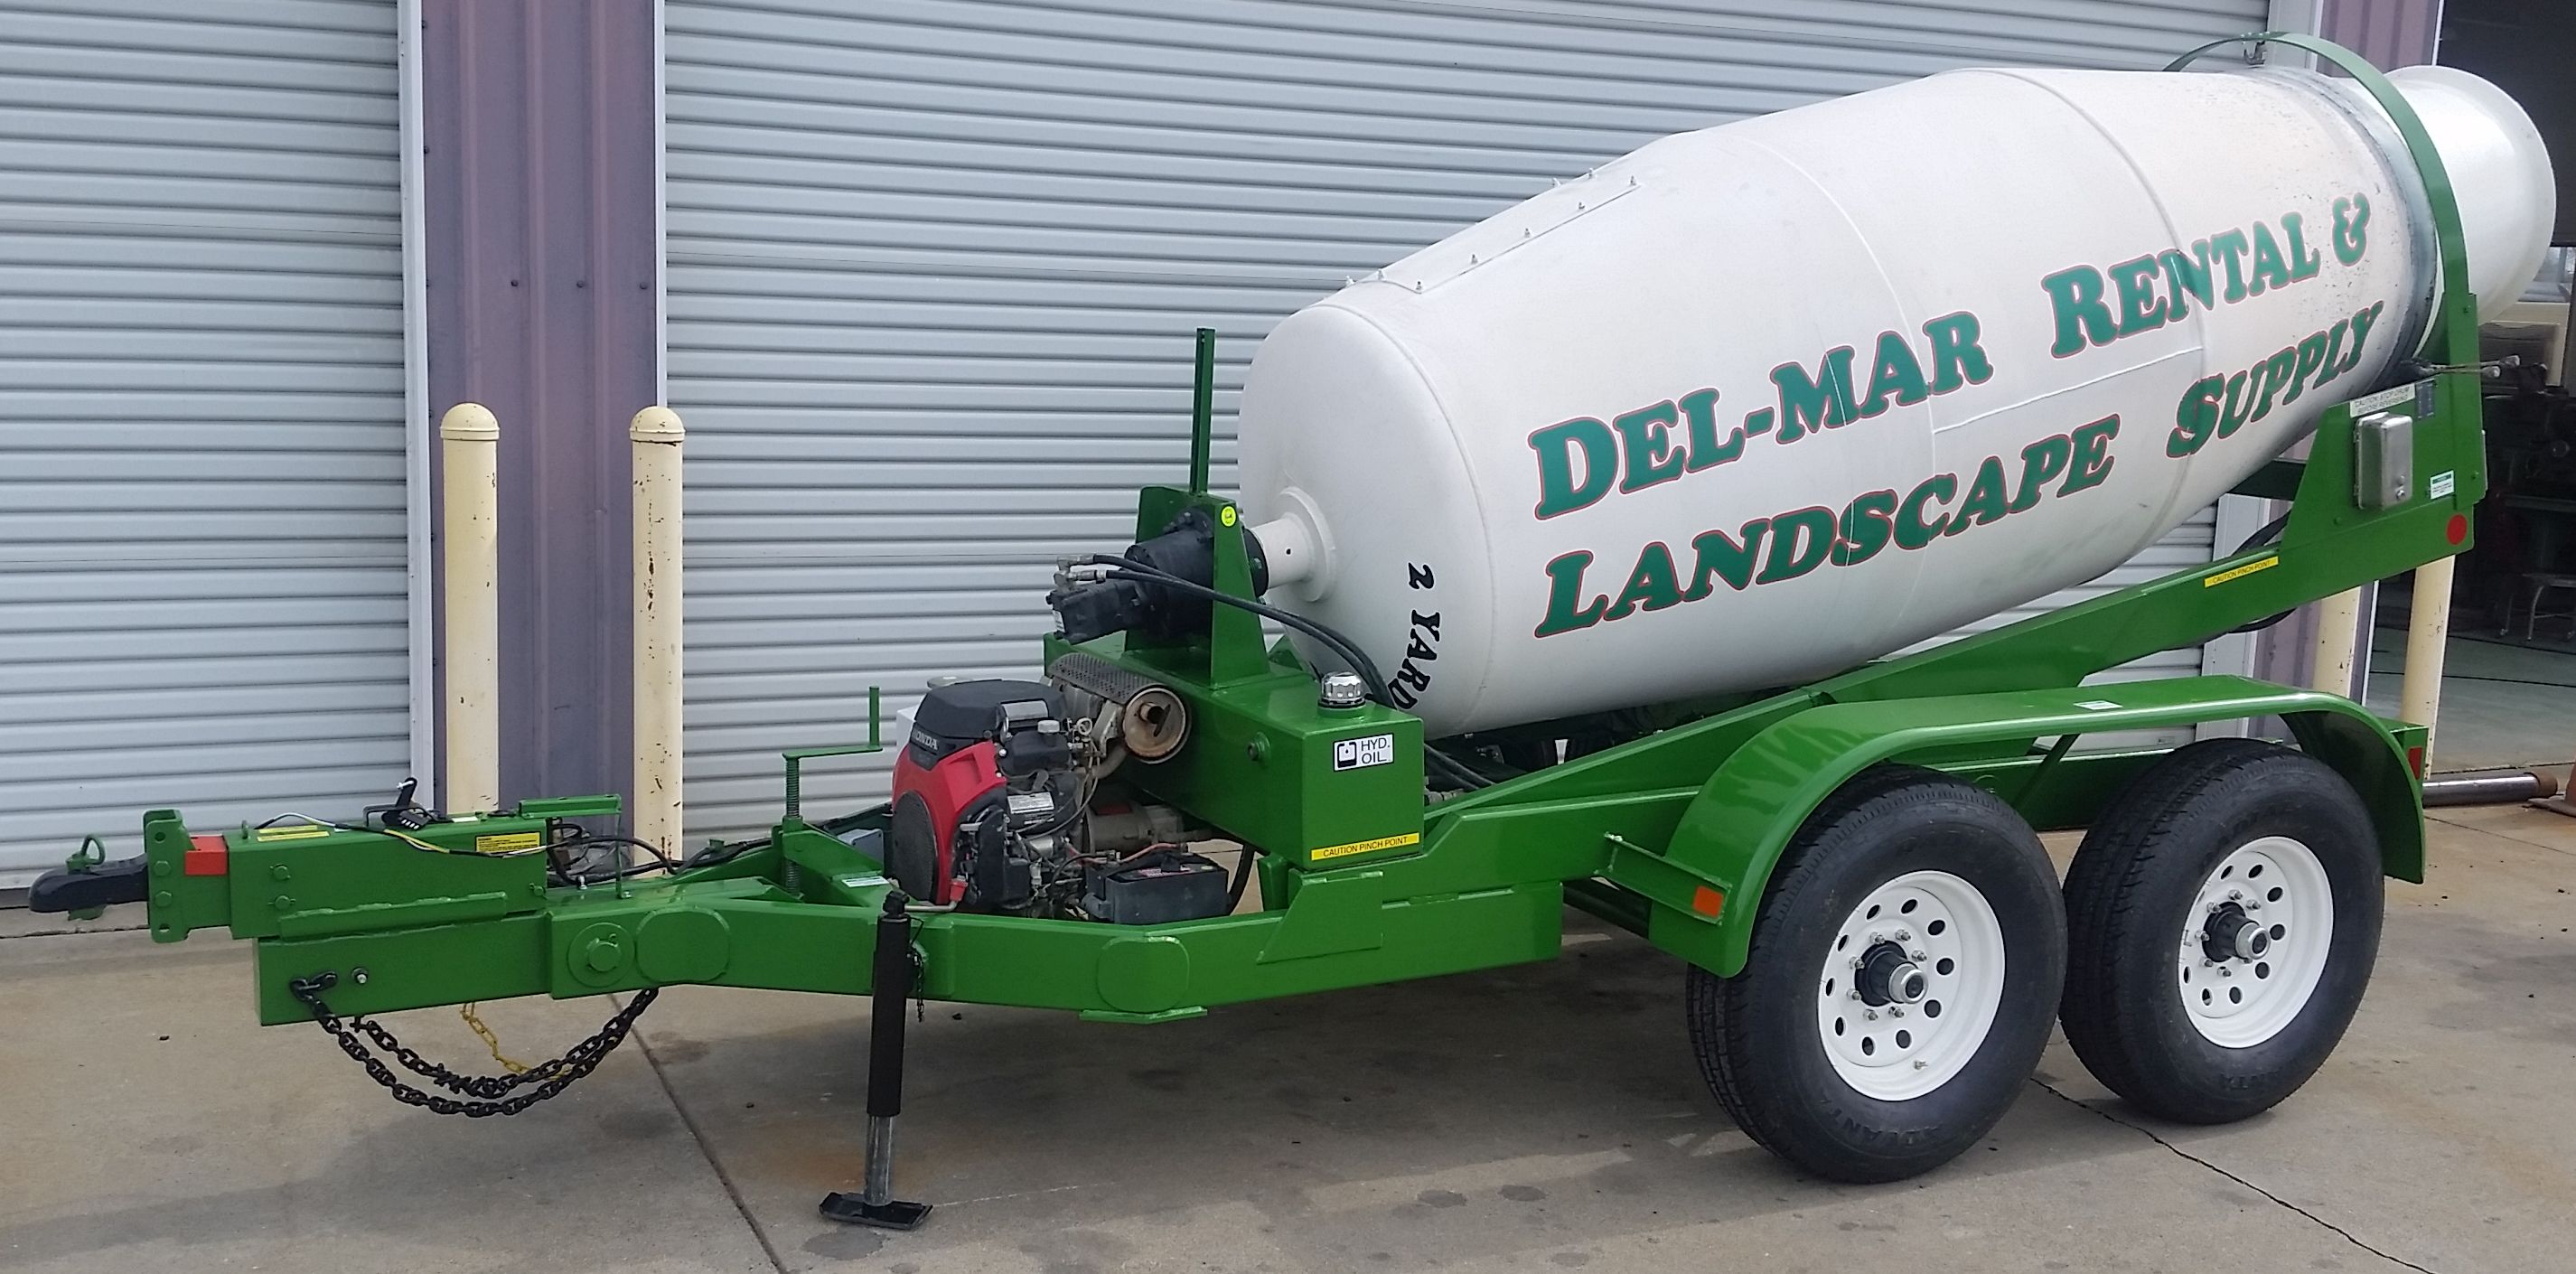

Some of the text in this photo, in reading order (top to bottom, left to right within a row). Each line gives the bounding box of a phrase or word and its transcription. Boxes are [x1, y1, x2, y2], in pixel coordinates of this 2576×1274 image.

[1528, 192, 2371, 520] DEL-MAR RENTAL &
[1533, 300, 2384, 638] LANDSCAPE SUPPLY
[2213, 570, 2237, 583] CAUTION
[2254, 560, 2271, 570] POINT
[1387, 562, 1440, 709] 2 YARD
[1361, 737, 1391, 752] HYD.
[1361, 752, 1387, 764] OIL
[1323, 836, 1408, 857] CAUTION PINCH POINT
